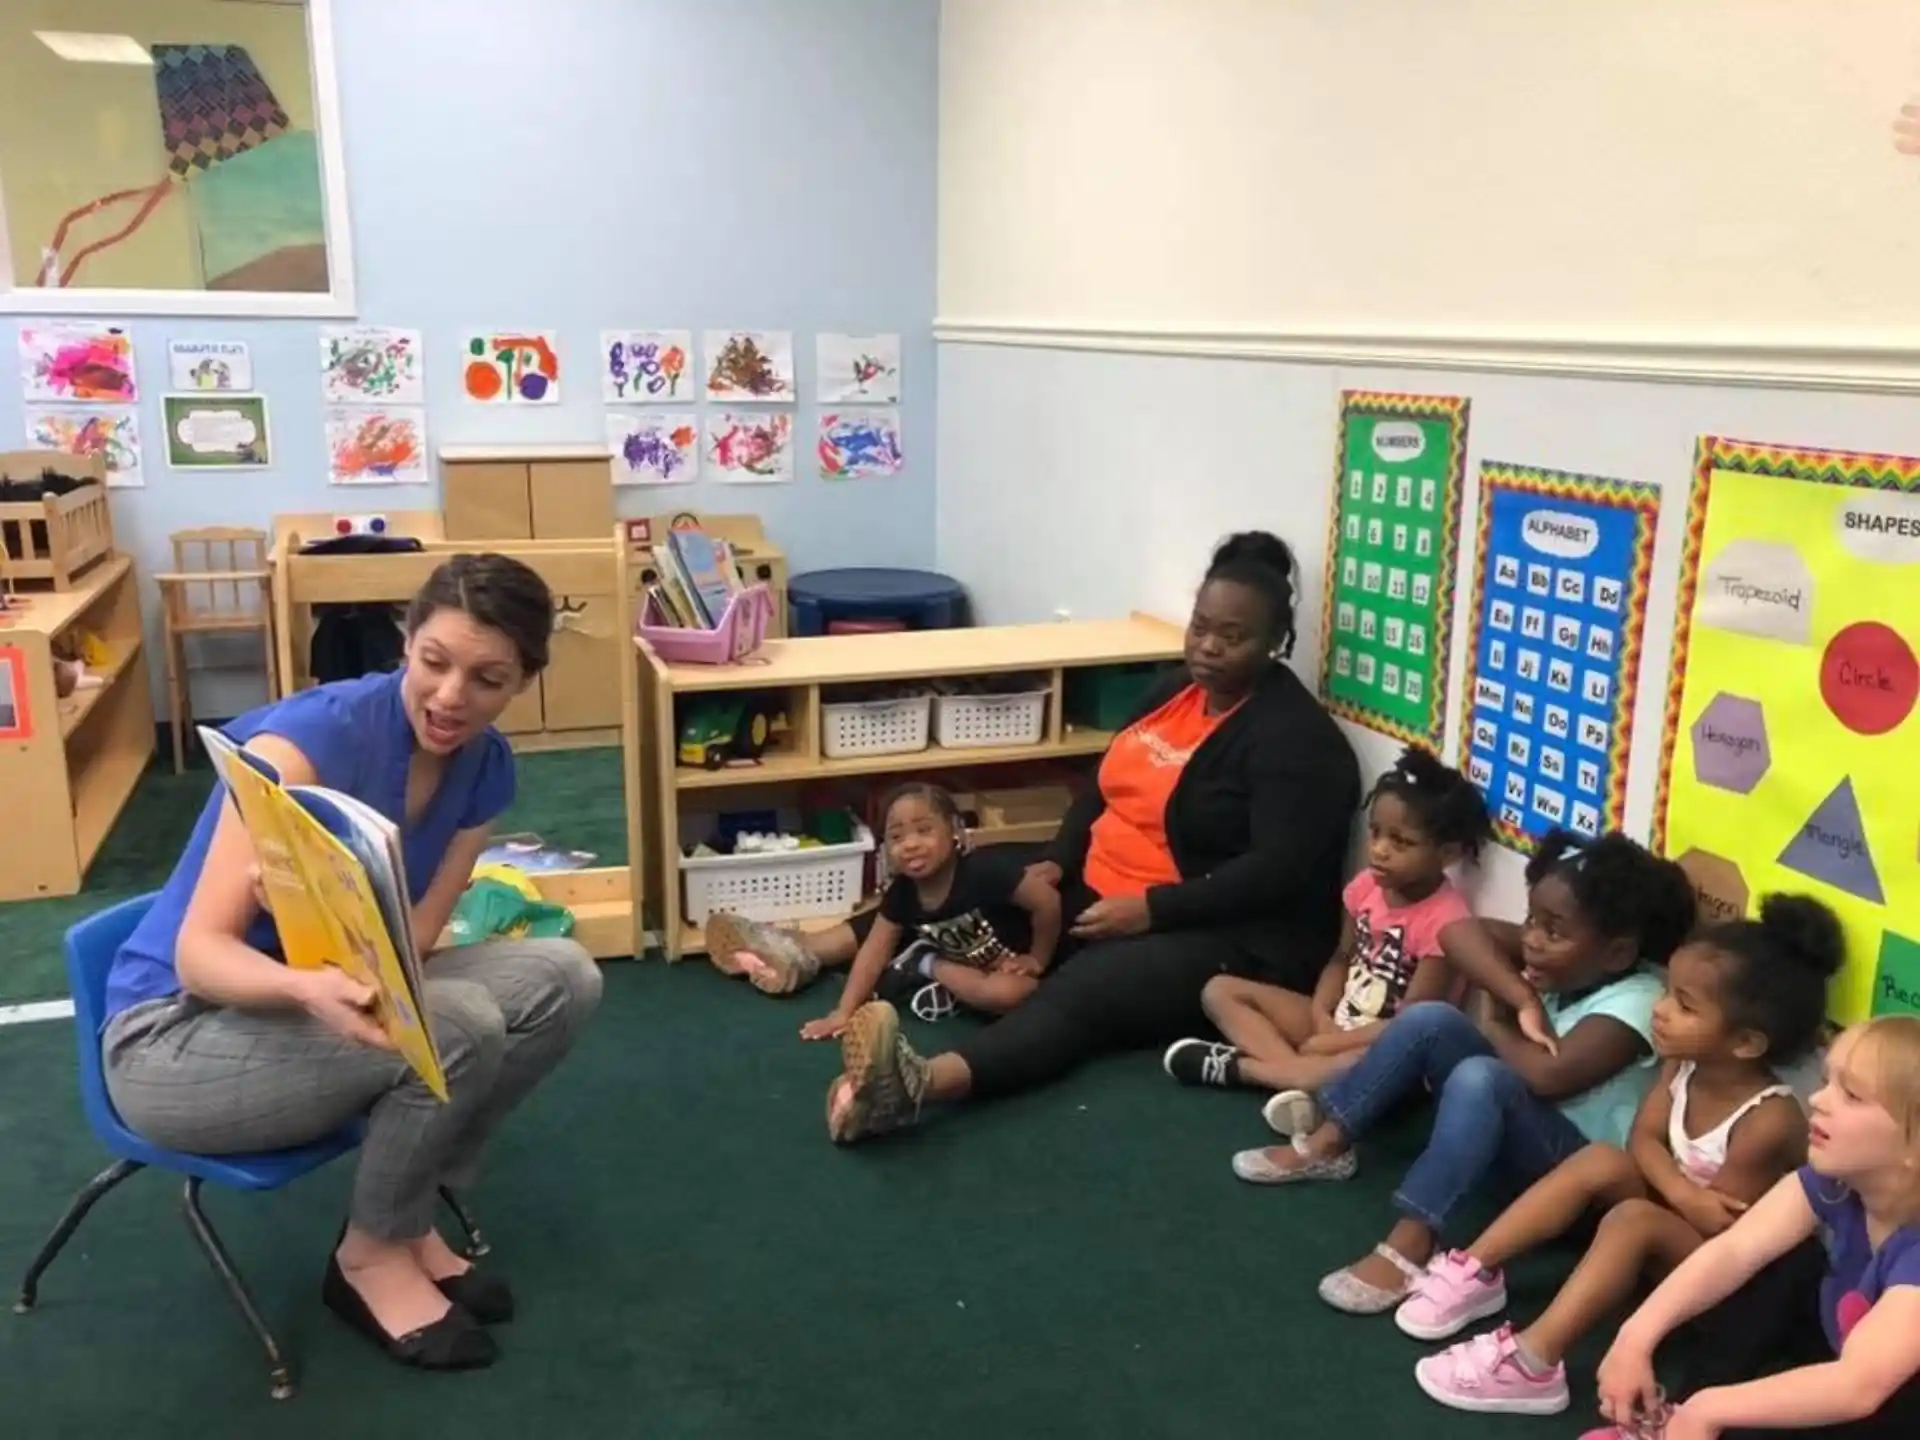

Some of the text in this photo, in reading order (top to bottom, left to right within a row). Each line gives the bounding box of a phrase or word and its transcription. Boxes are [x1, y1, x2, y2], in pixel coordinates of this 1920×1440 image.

[1528, 519, 1590, 544] ALPHABET
[1845, 511, 1920, 537] SHAPES
[1367, 575, 1379, 589] 10
[1392, 581, 1405, 595] 11
[1415, 585, 1426, 601] 12
[1499, 563, 1618, 604] Aa Bb Cc Dd
[1718, 575, 1801, 613] Trapezoid
[1364, 621, 1374, 635] 14
[1410, 633, 1422, 650] 16
[1494, 608, 1609, 653] Ee Ff Gg Hh
[1520, 660, 1533, 678] Jj
[1550, 669, 1567, 685] Kk
[1592, 682, 1605, 698] Ll
[1839, 659, 1896, 693] Circle
[1479, 685, 1604, 745] Mm Nn Oo Pp
[1477, 727, 1595, 786] Qq Rr Ss Tt
[1702, 723, 1760, 757] Hexagon
[1471, 766, 1594, 830] Uu Vv Ww Xx
[1503, 808, 1519, 823] Zz
